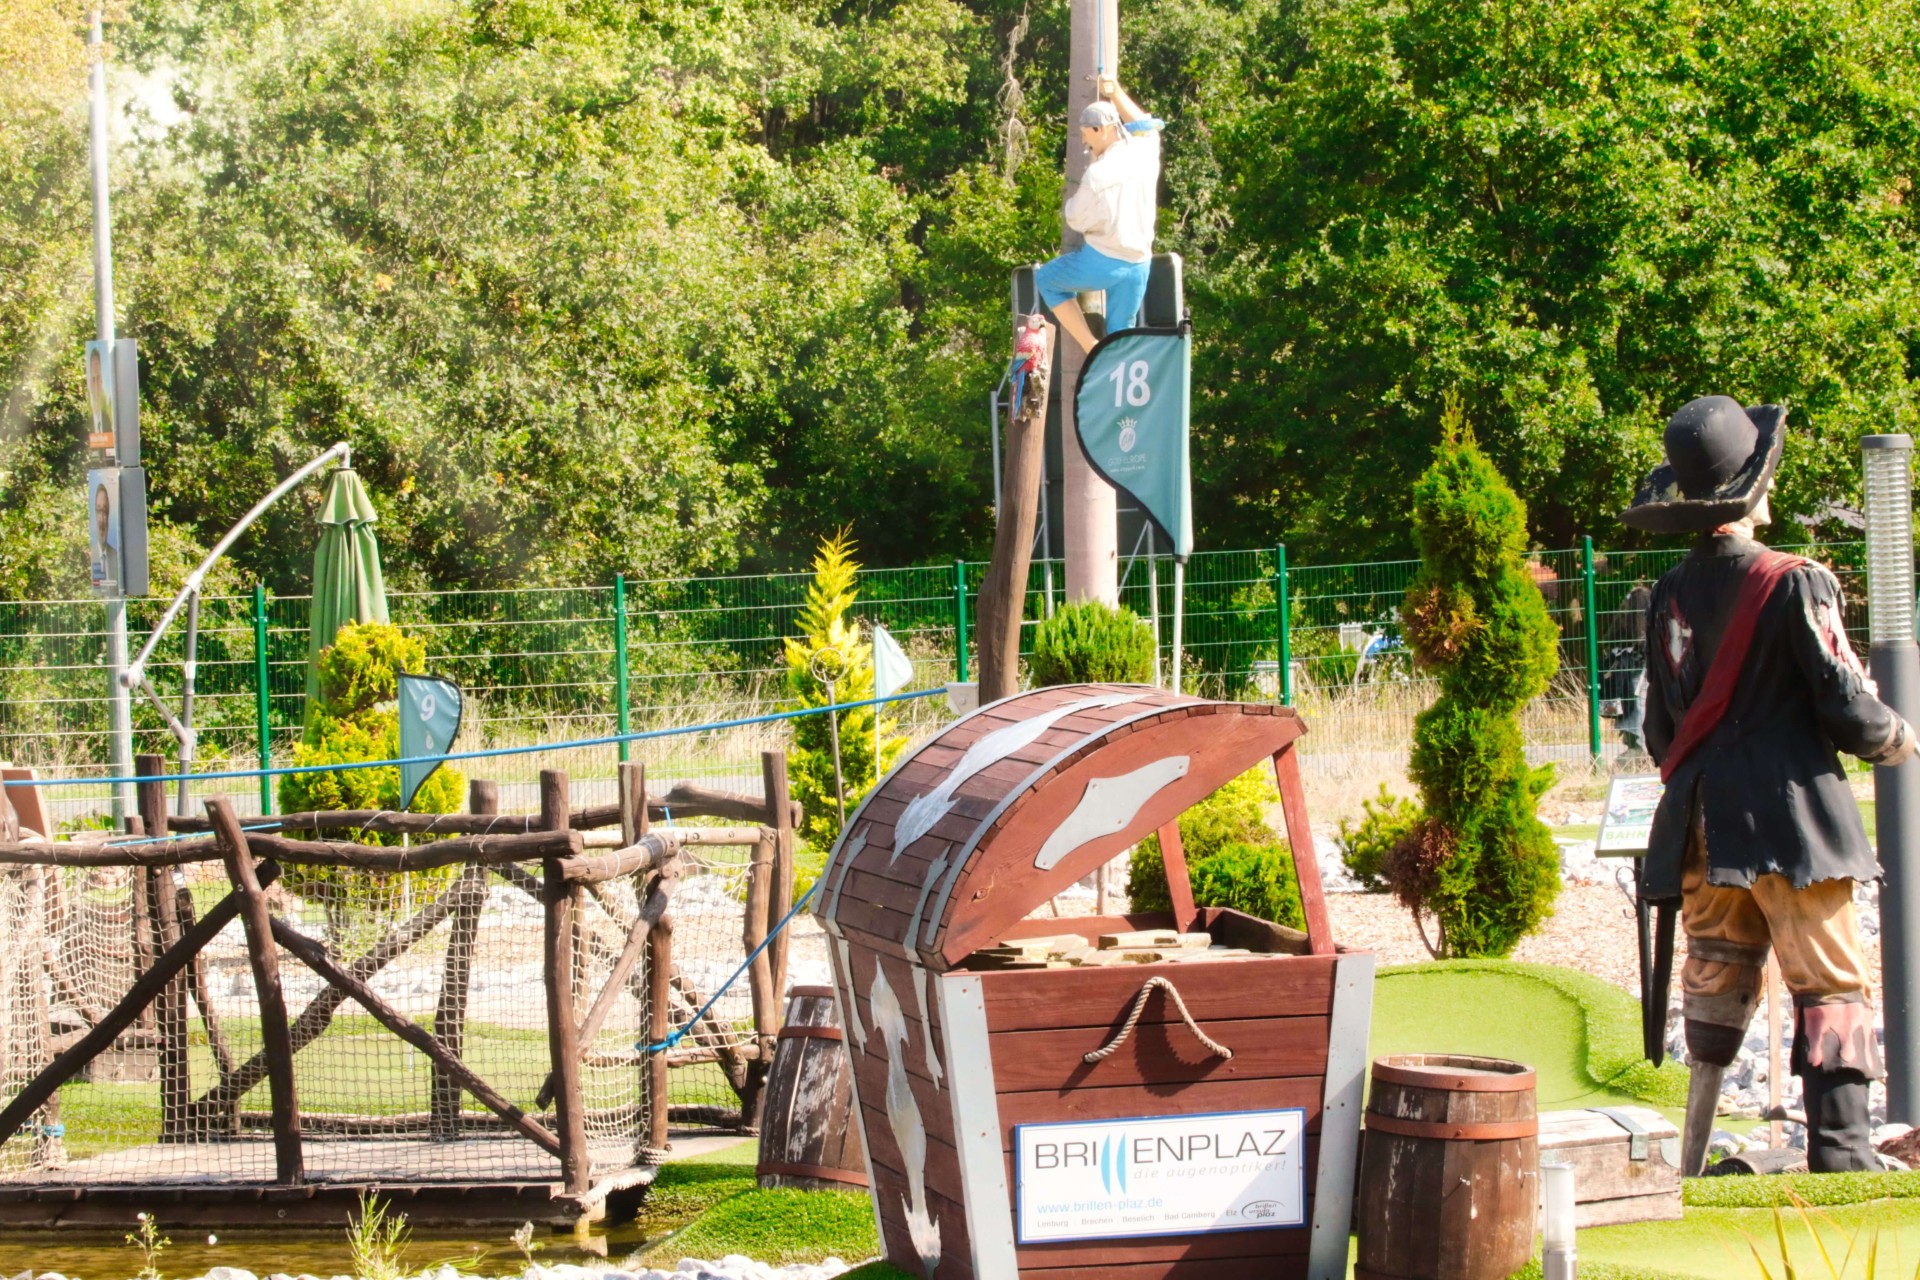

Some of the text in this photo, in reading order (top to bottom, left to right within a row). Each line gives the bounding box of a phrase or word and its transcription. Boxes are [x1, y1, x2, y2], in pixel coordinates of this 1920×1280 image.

[1109, 360, 1150, 407] 18
[420, 694, 436, 721] 9
[1605, 830, 1647, 840] BAHN
[1133, 1160, 1286, 1179] die augenoptiker!
[1037, 1196, 1163, 1214] www.brillen-plaz.de
